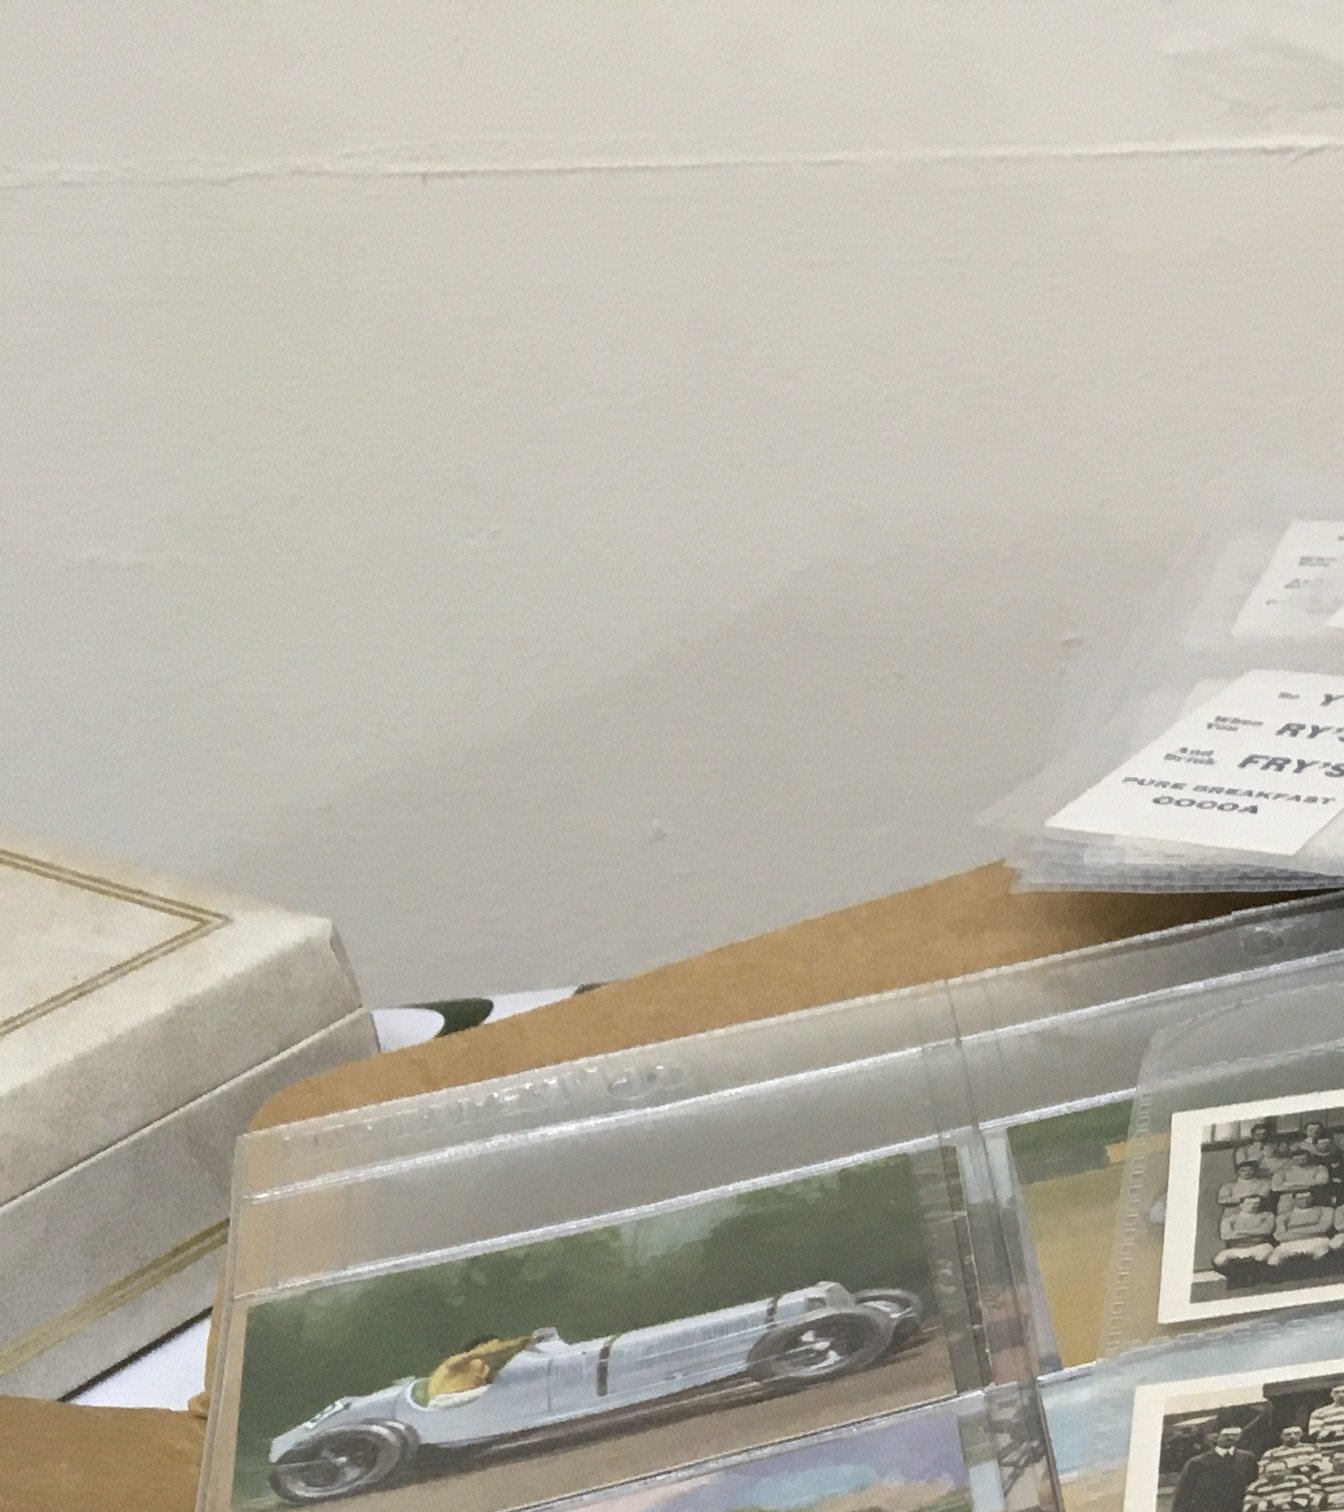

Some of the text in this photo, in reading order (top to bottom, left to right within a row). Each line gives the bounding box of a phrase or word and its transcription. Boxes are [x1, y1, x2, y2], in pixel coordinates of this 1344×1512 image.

[1121, 777, 1337, 805] PURE BREAKFAST
[1152, 796, 1259, 814] COCOA
